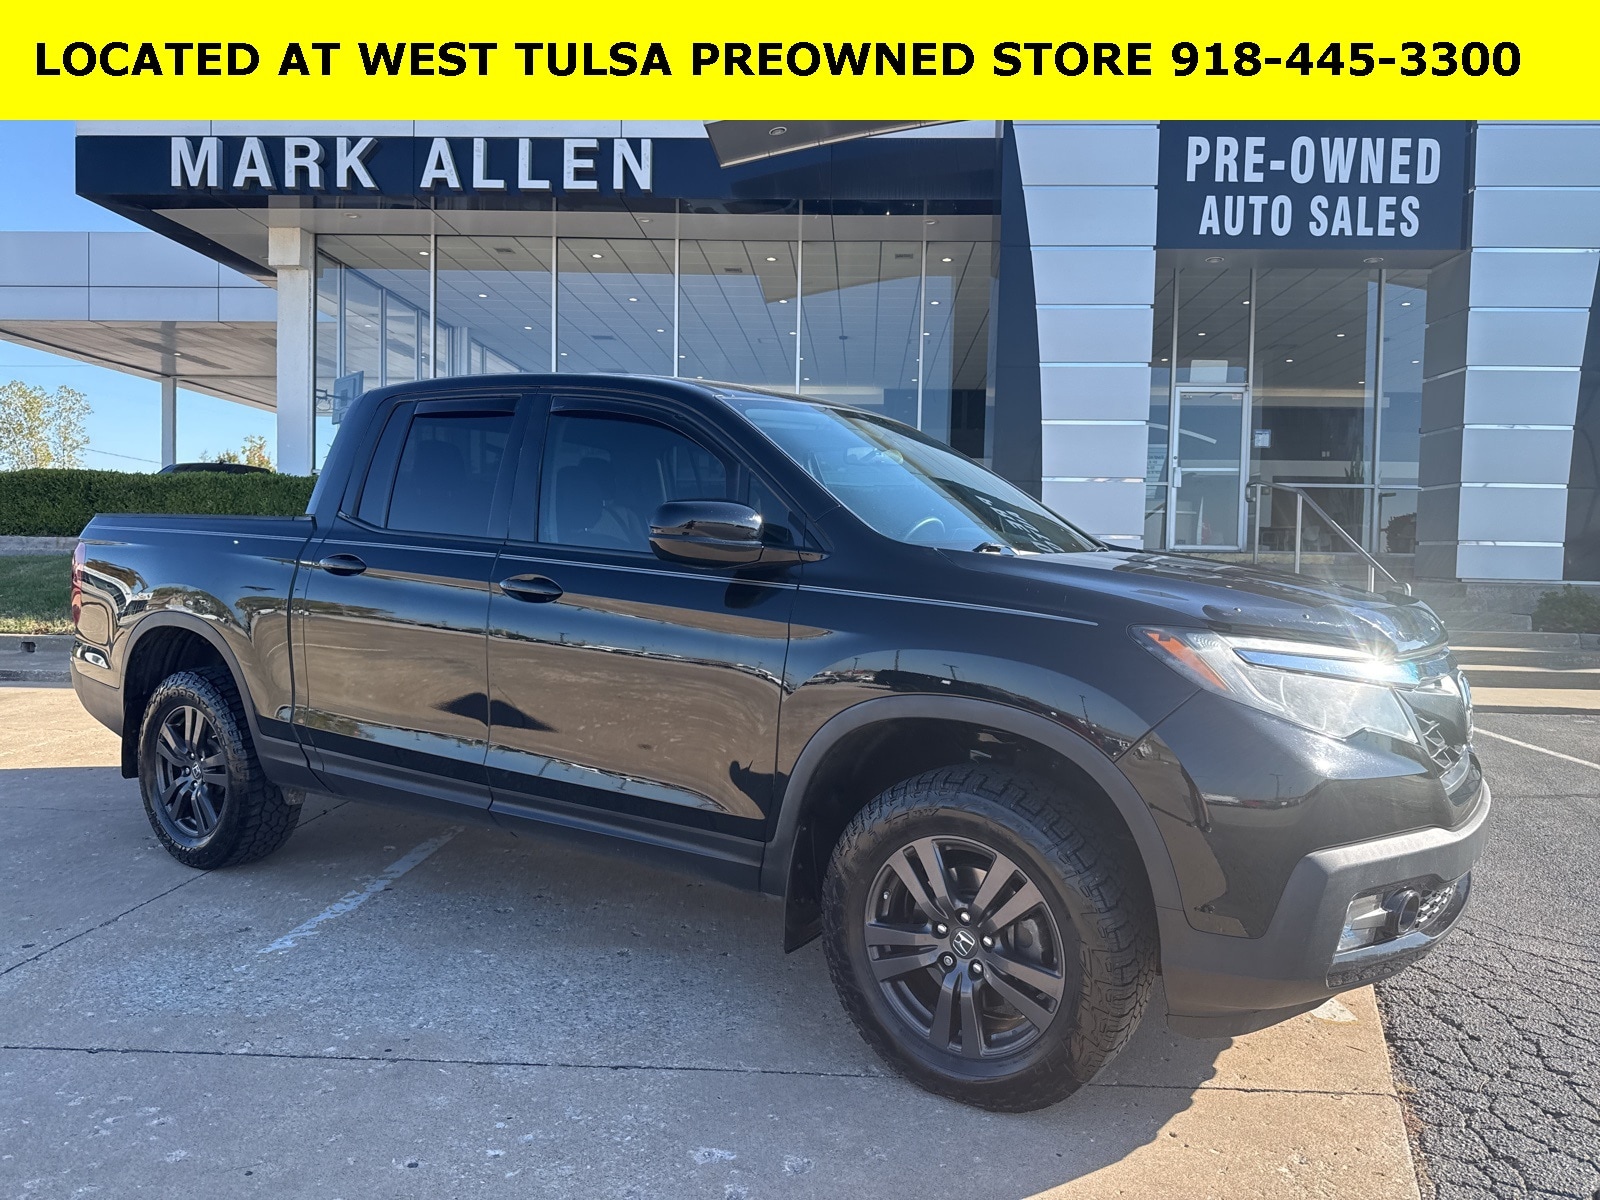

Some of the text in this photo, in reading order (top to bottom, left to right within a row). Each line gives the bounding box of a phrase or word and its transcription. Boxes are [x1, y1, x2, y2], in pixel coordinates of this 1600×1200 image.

[171, 136, 653, 192] MARK ALLEN
[1186, 136, 1441, 184] PRE-OWNED
[1198, 194, 1421, 238] AUTO SALES
